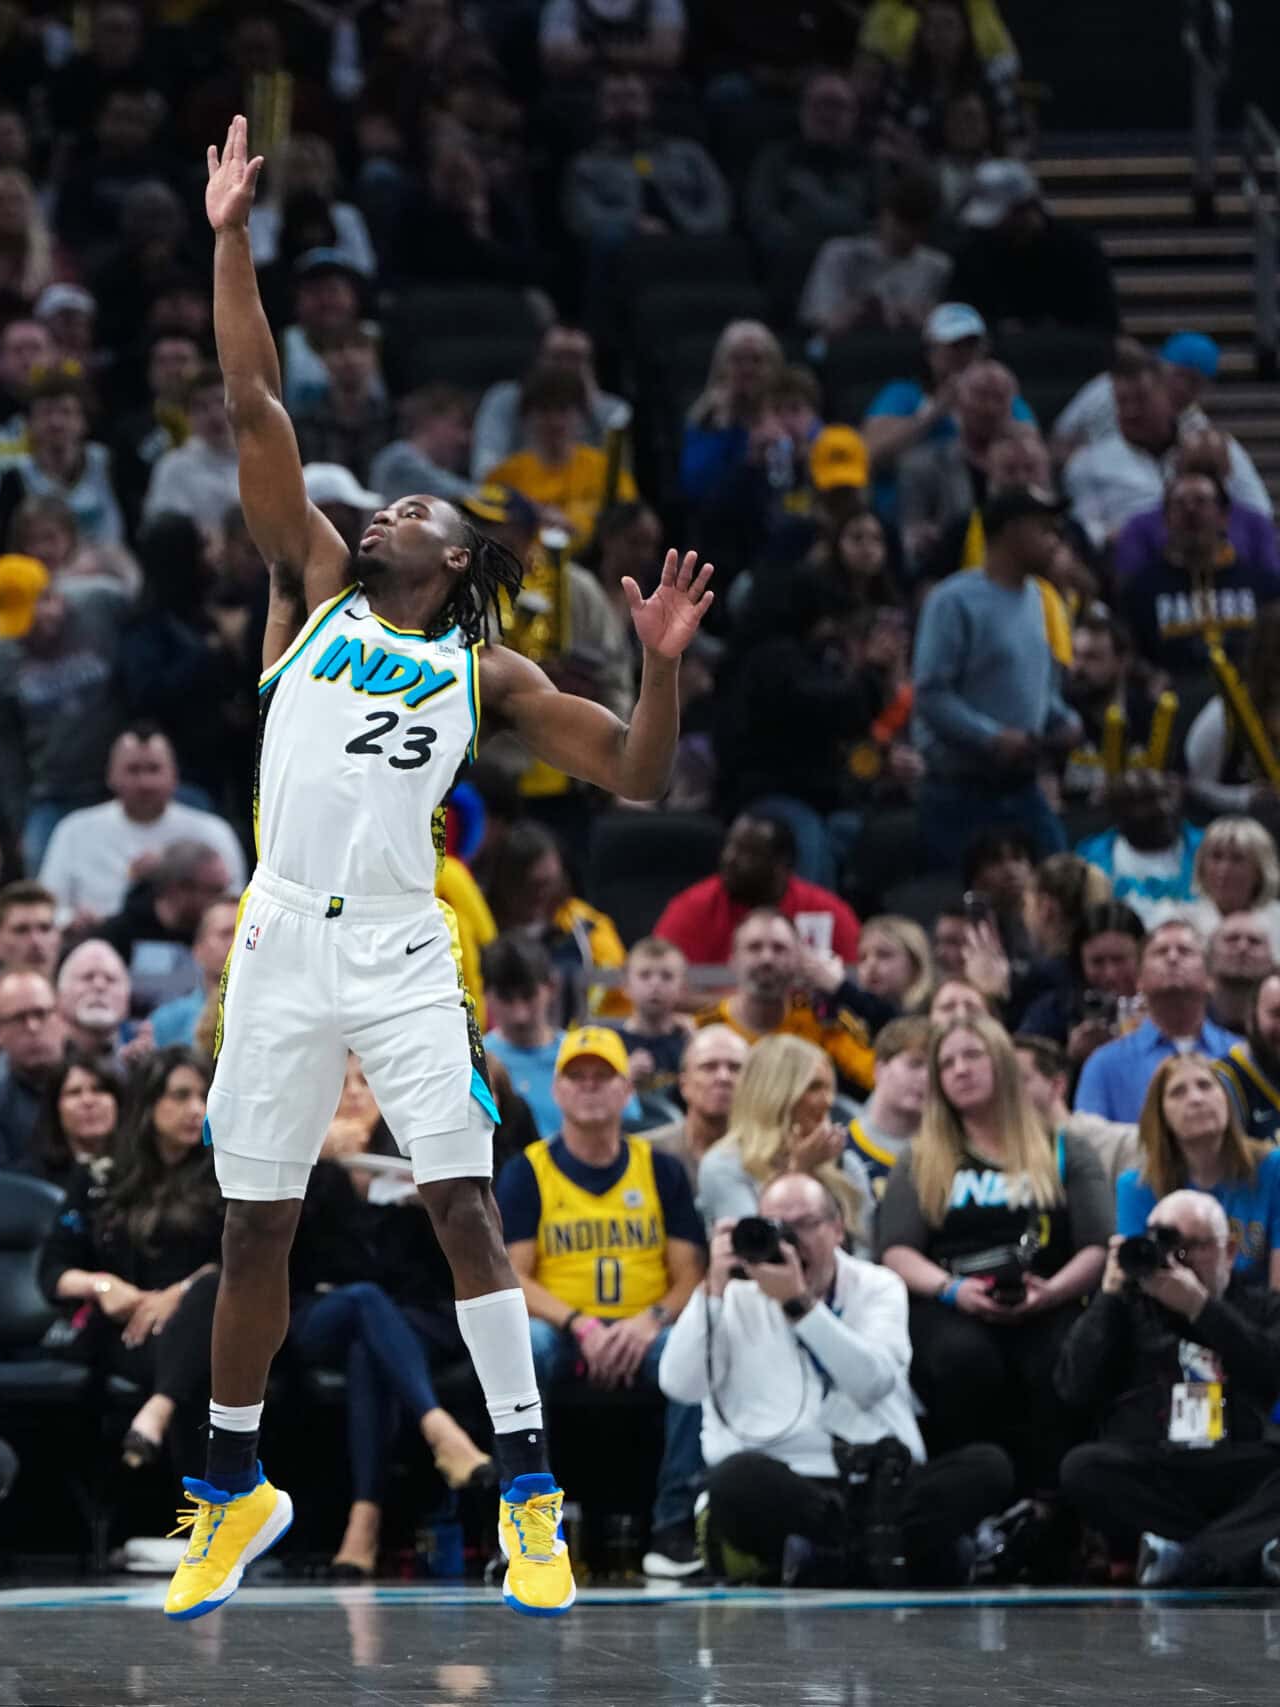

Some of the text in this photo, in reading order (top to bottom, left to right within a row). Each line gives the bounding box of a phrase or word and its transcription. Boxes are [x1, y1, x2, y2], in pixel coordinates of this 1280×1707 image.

[310, 634, 459, 711] INDY
[345, 711, 438, 770] 23
[543, 1215, 660, 1257] INDIANA
[595, 1256, 623, 1306] 0
